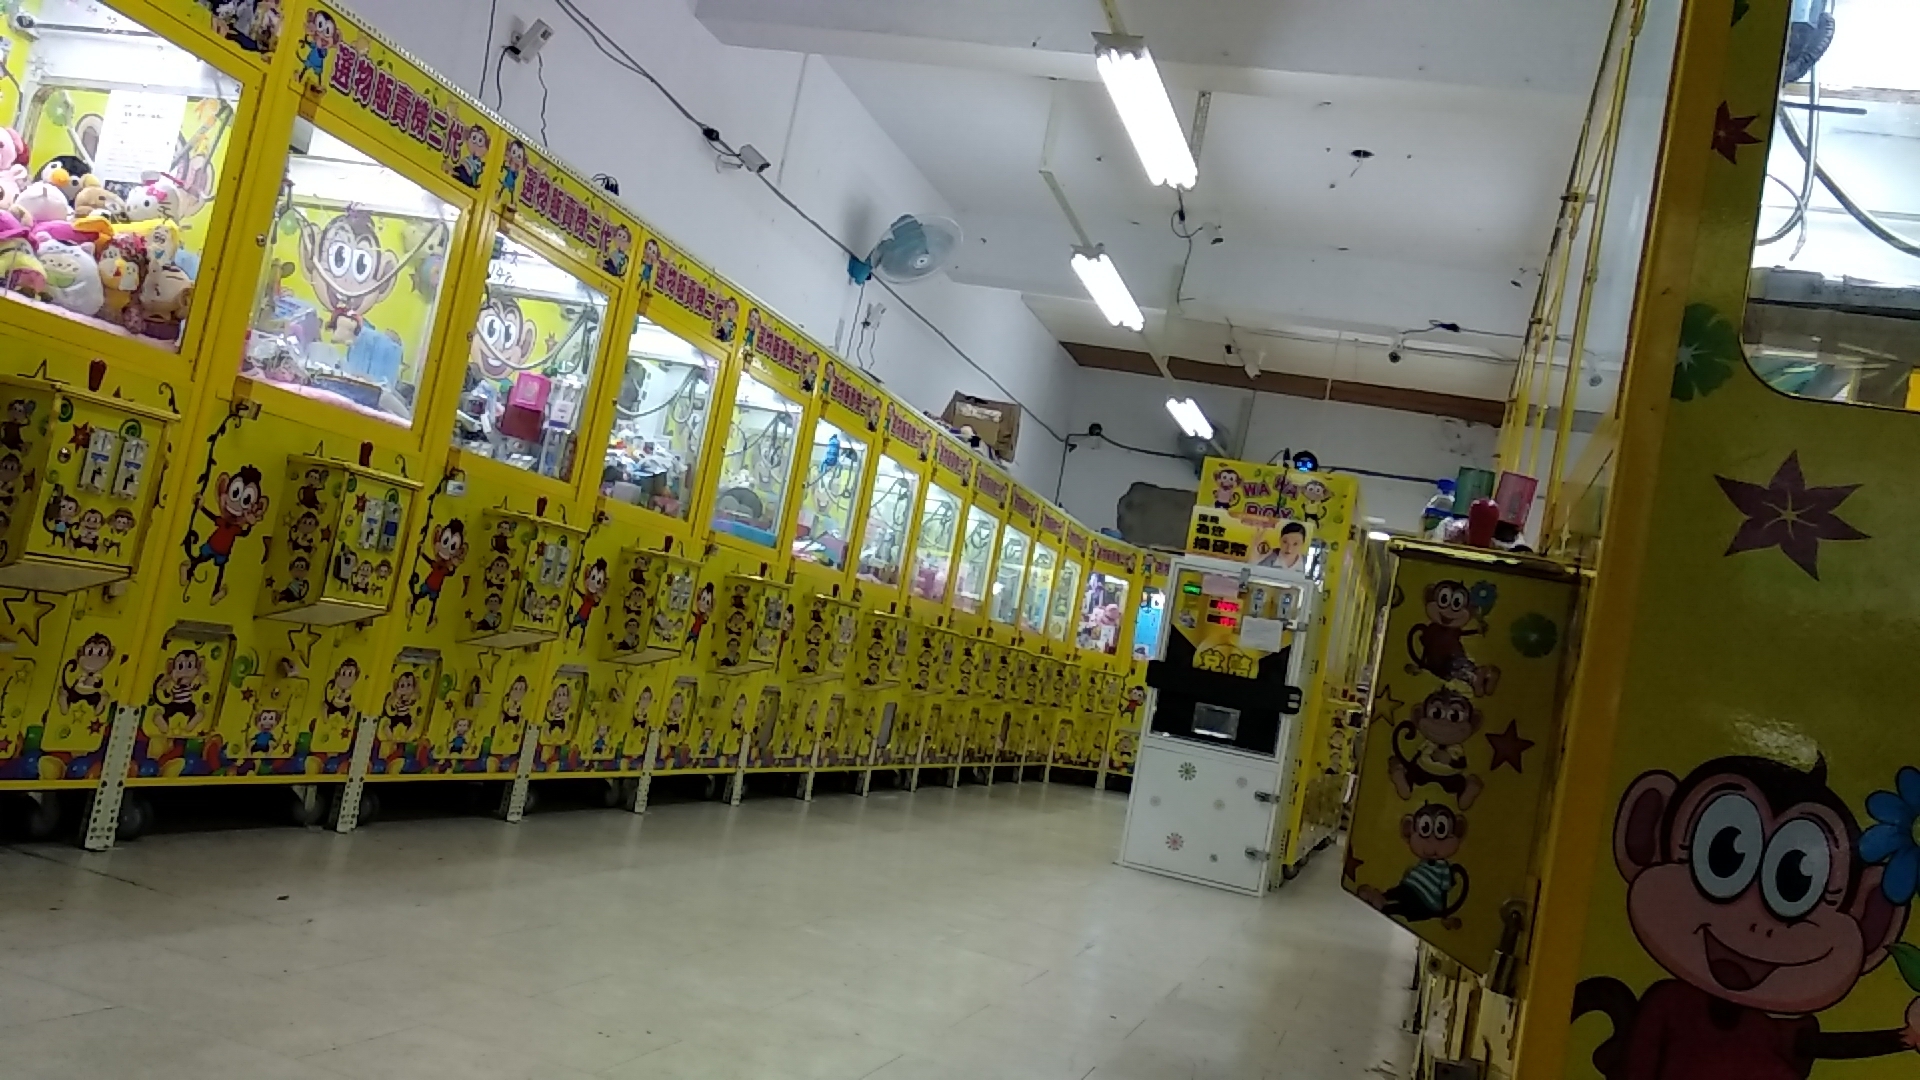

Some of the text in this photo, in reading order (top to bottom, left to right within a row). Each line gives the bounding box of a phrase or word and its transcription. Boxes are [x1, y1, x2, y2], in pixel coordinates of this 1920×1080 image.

[329, 41, 466, 164] 選物販賣機二代
[518, 164, 613, 258] 選物販賣機二代
